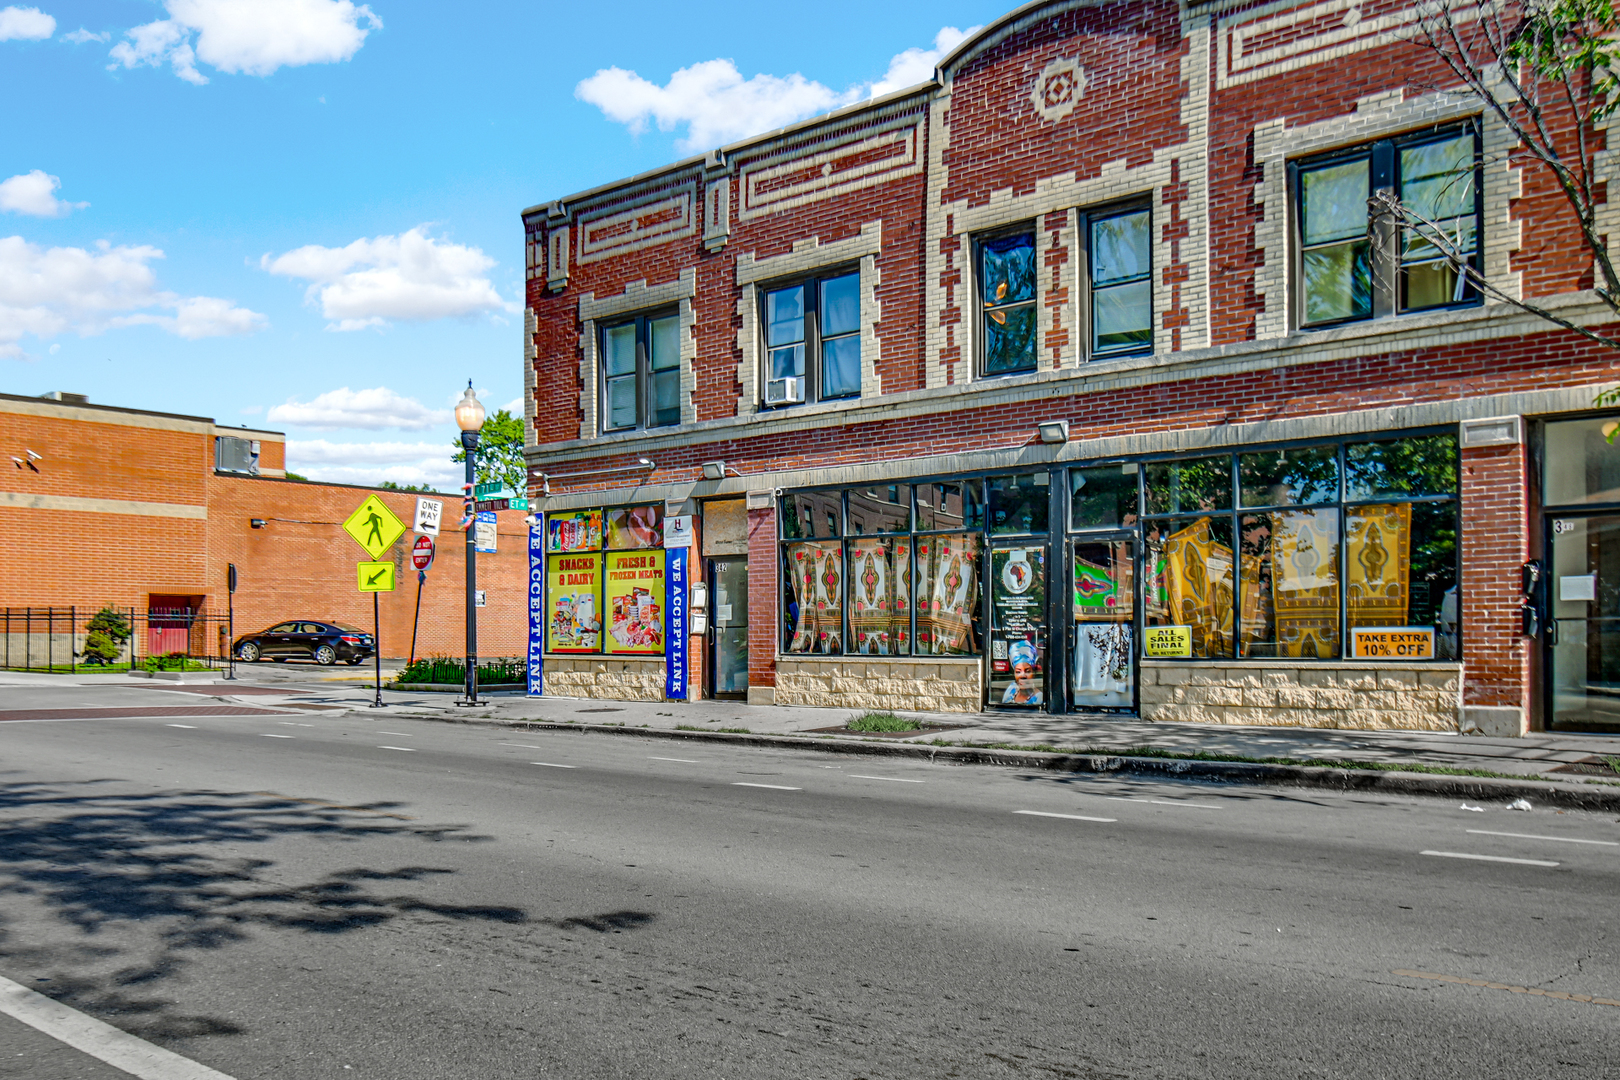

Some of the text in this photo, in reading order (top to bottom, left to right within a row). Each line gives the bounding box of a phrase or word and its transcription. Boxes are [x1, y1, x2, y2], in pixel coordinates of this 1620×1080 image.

[422, 501, 439, 512] ONE
[420, 510, 438, 520] WAY
[559, 558, 595, 571] SNACKS
[617, 556, 656, 569] FRESH &
[715, 563, 727, 572] 342
[559, 573, 595, 586] & DAIRY
[610, 569, 663, 580] FROZEN MEATS
[529, 518, 541, 694] WE ACCEPT LINK
[672, 557, 682, 692] WE ACCEPT LINK
[1150, 635, 1184, 643] SALES
[1358, 634, 1429, 642] TAKE EXTRA
[1363, 644, 1425, 656] 10% OFF
